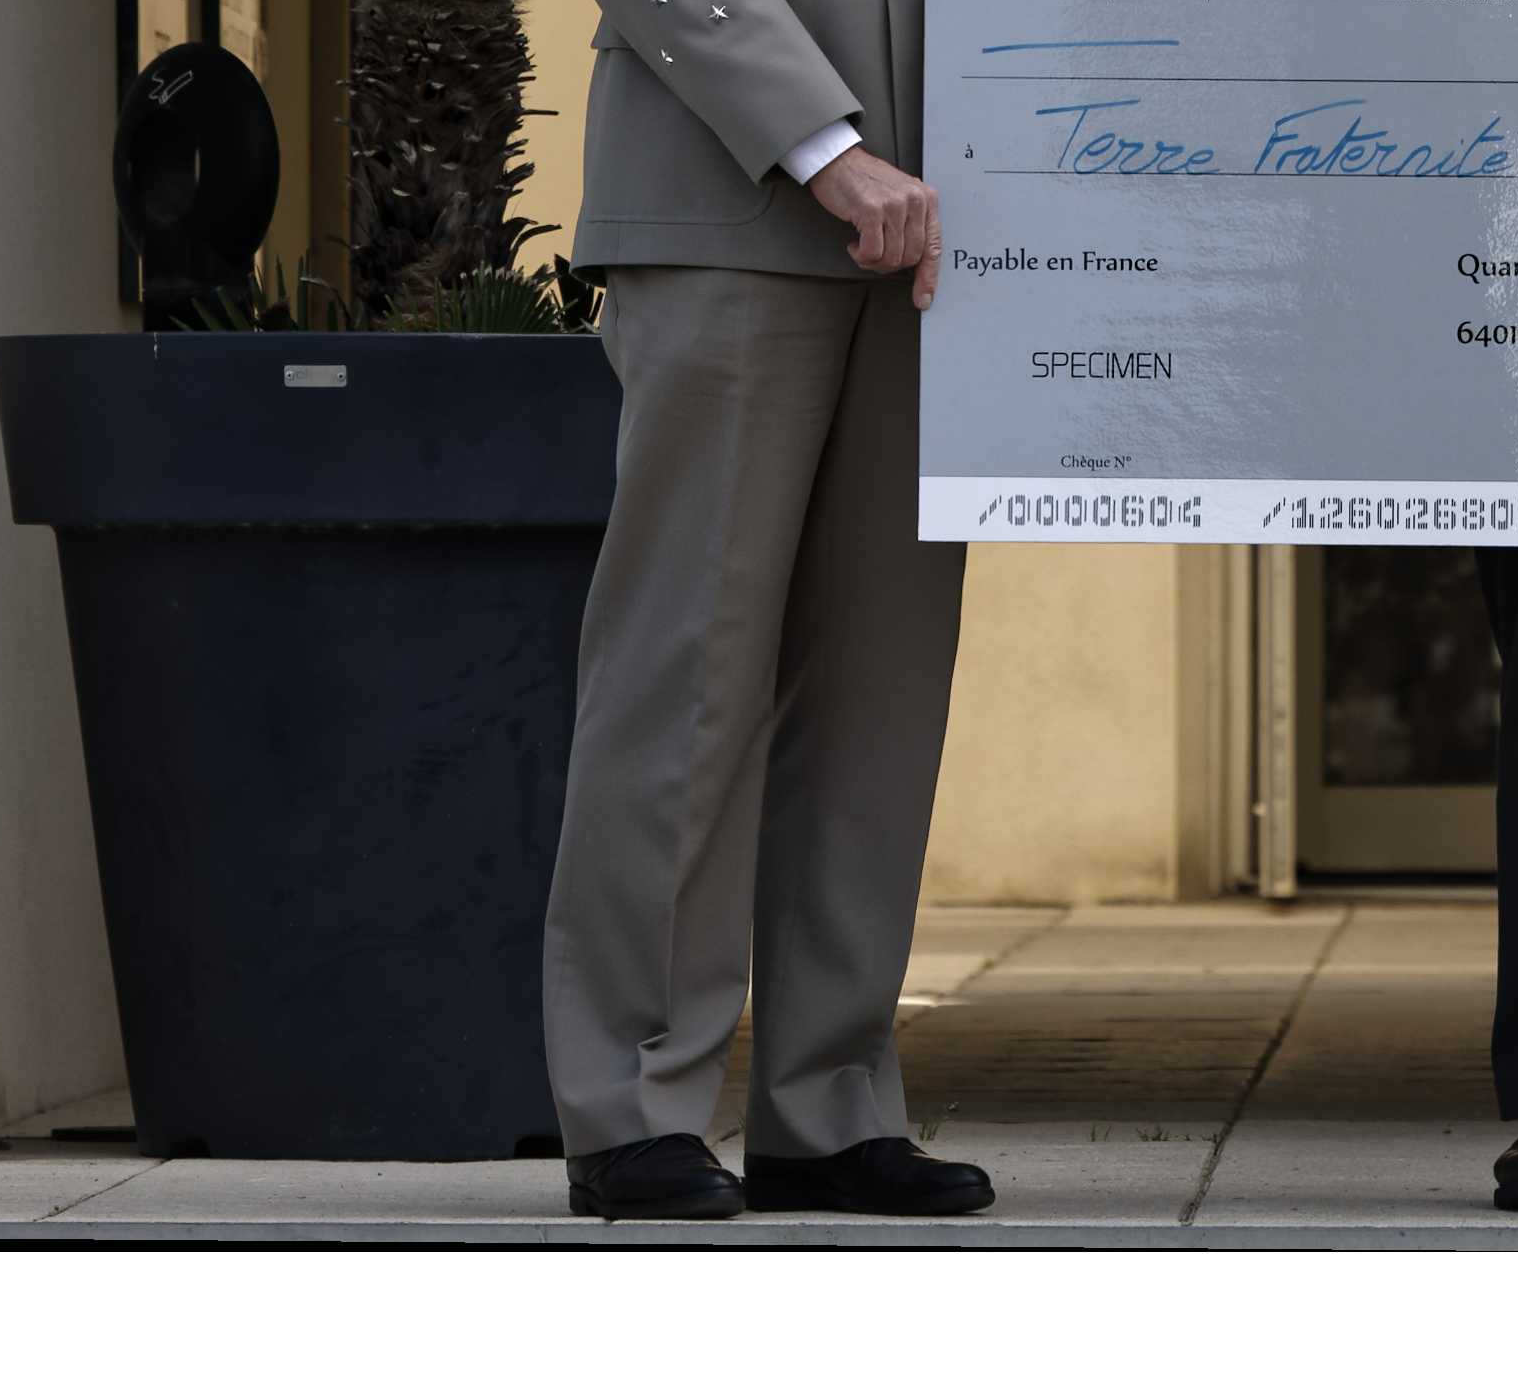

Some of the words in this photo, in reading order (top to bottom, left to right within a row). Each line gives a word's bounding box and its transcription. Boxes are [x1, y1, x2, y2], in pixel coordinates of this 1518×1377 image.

[964, 143, 975, 160] à
[1036, 98, 1217, 177] Terre
[953, 248, 1039, 277] Payable
[1046, 256, 1075, 273] en
[1082, 250, 1160, 274] France
[1031, 351, 1173, 381] SPECIMEN
[1060, 453, 1111, 473] Chèque
